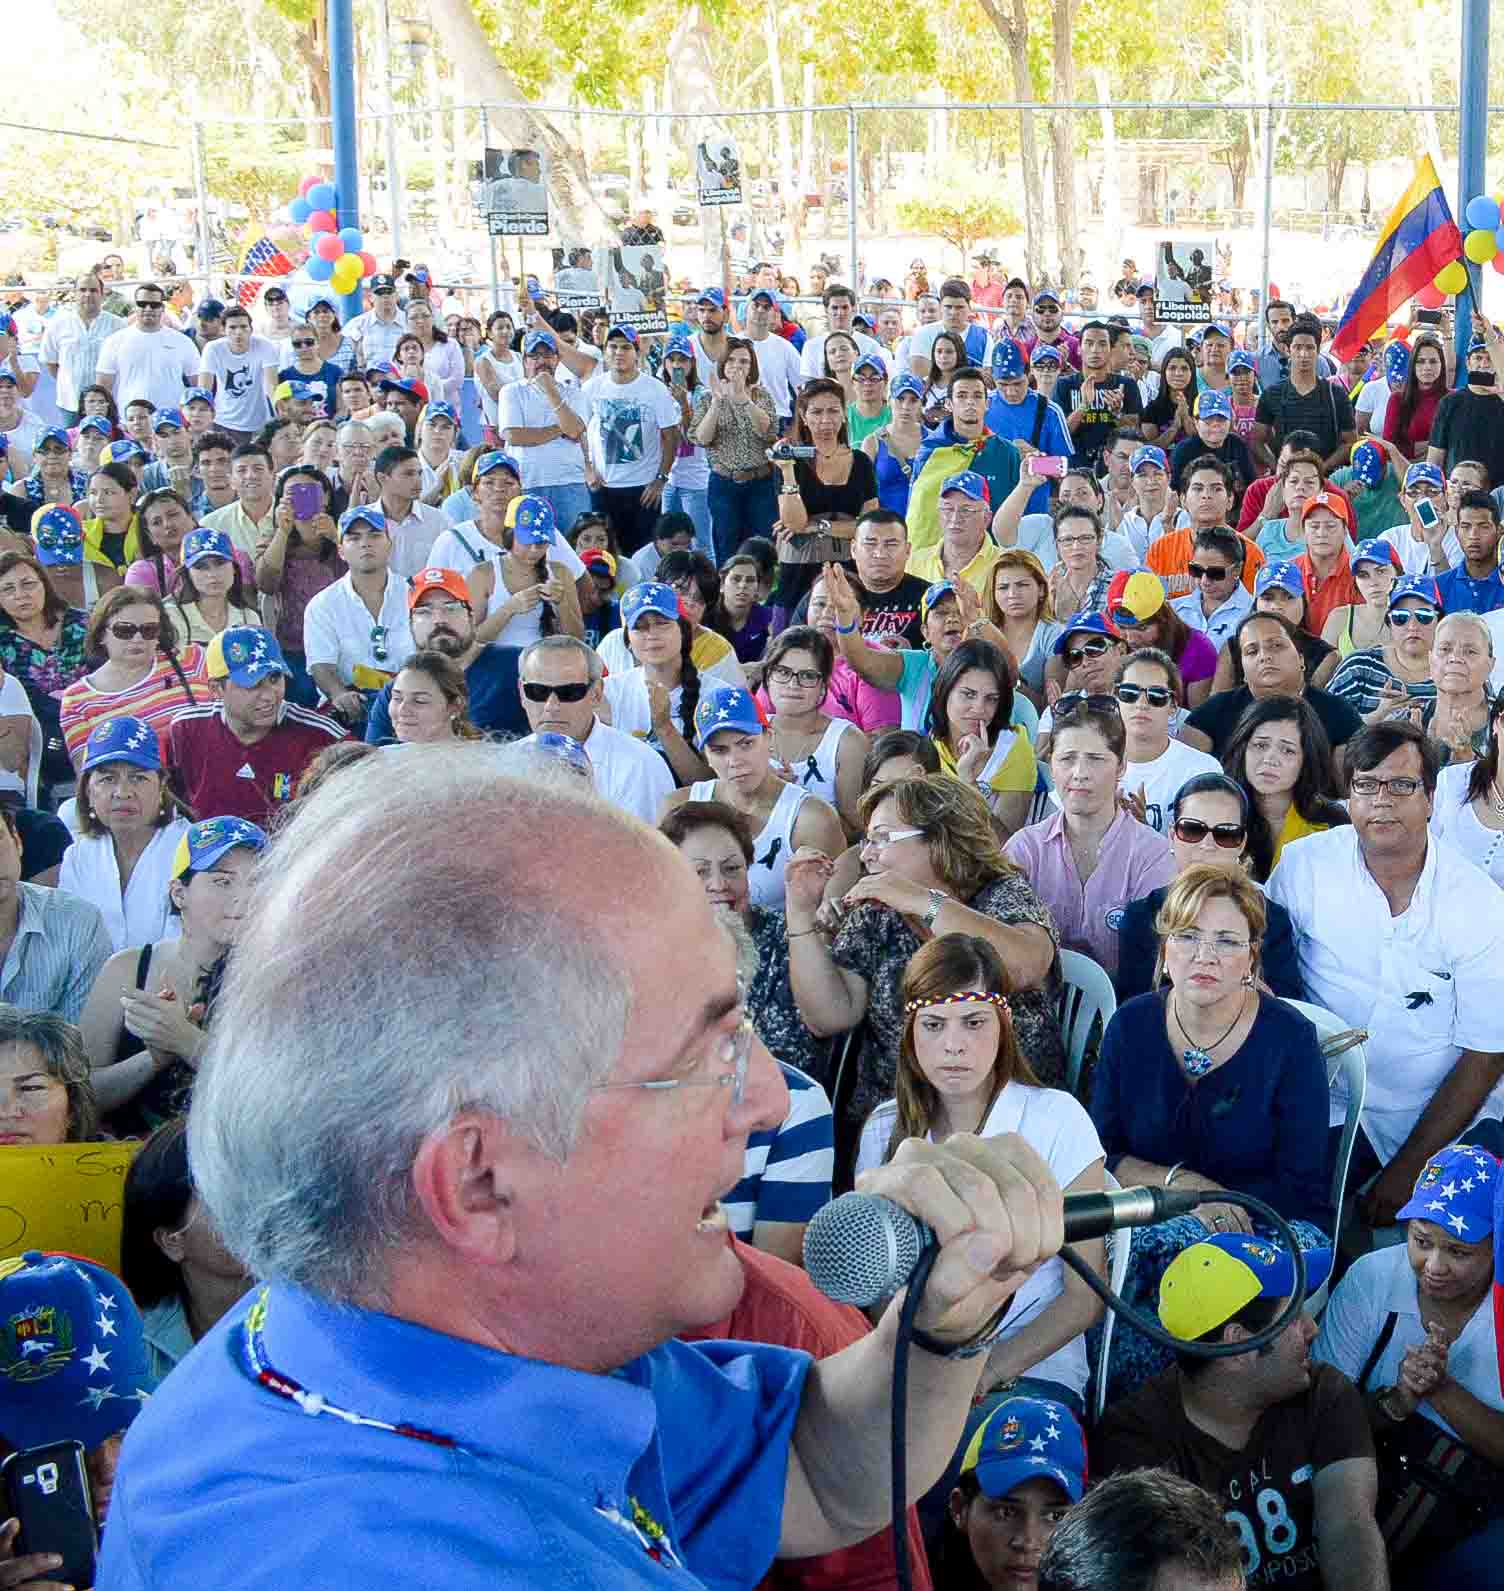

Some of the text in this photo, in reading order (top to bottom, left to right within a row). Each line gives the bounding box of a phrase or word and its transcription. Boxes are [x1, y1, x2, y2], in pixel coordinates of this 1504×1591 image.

[490, 219, 547, 233] Pierde
[1155, 302, 1209, 312] #LiberenA
[1155, 311, 1210, 321] Leopoldo
[1232, 417, 1257, 432] VAN
